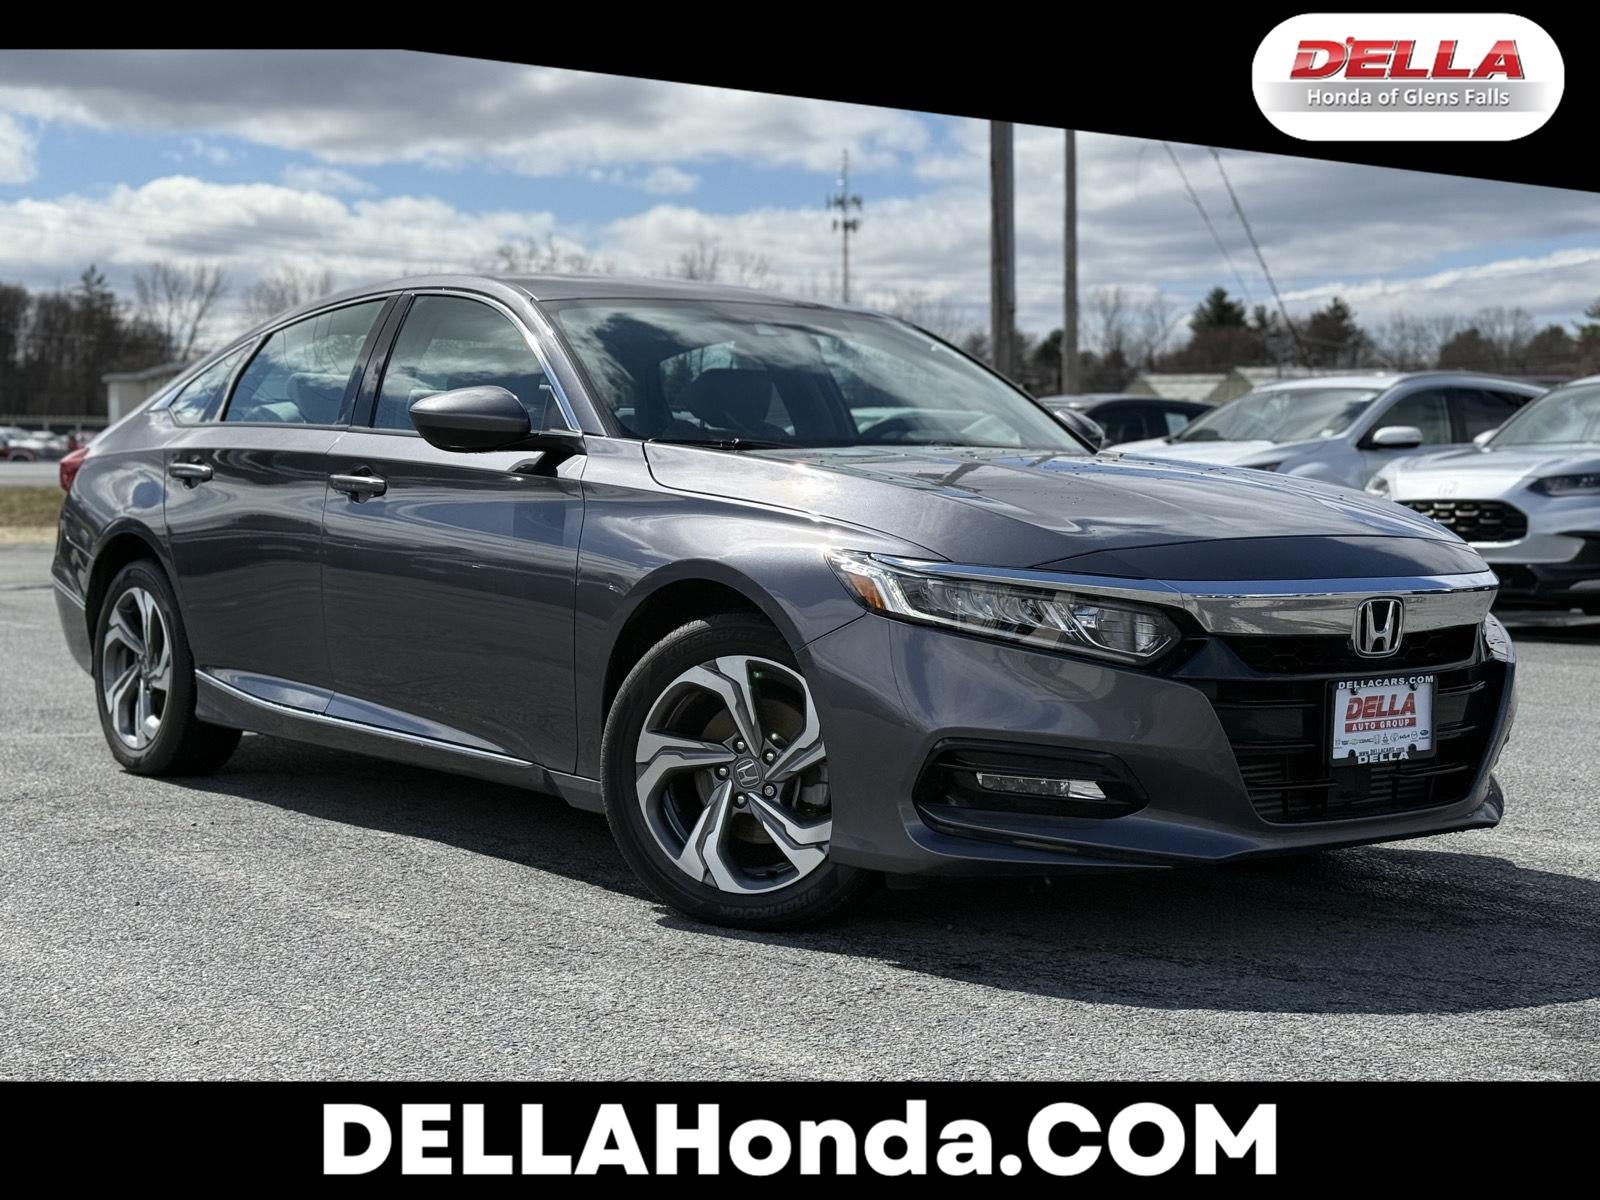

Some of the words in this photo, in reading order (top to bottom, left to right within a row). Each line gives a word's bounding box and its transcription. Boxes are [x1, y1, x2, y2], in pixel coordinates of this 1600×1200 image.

[1338, 675, 1434, 690] DELLACARS.COM
[1345, 692, 1416, 721] DELLA
[1352, 721, 1377, 731] AUTO
[1380, 719, 1410, 729] GROUP
[1357, 751, 1410, 765] DELLA
